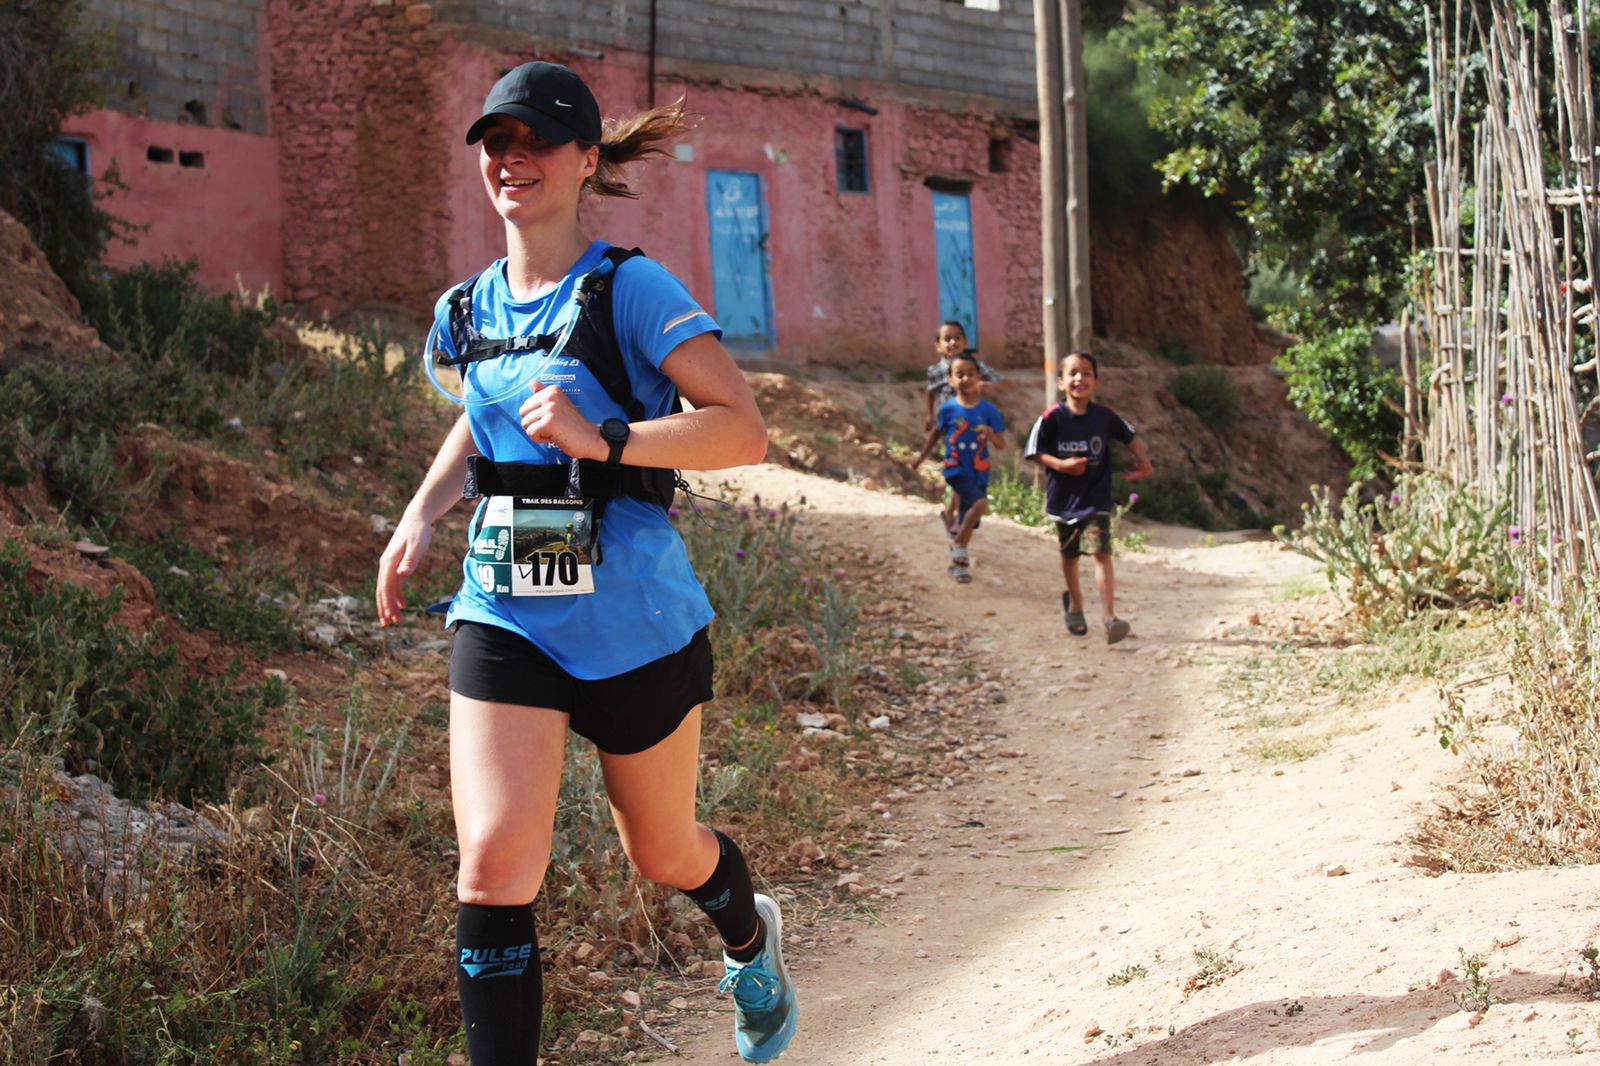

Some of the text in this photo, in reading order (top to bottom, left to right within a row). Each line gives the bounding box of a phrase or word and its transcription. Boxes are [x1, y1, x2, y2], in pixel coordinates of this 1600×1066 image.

[1058, 440, 1088, 452] KIDS
[526, 552, 579, 586] 170
[496, 585, 510, 593] Km
[460, 943, 532, 963] PULSE
